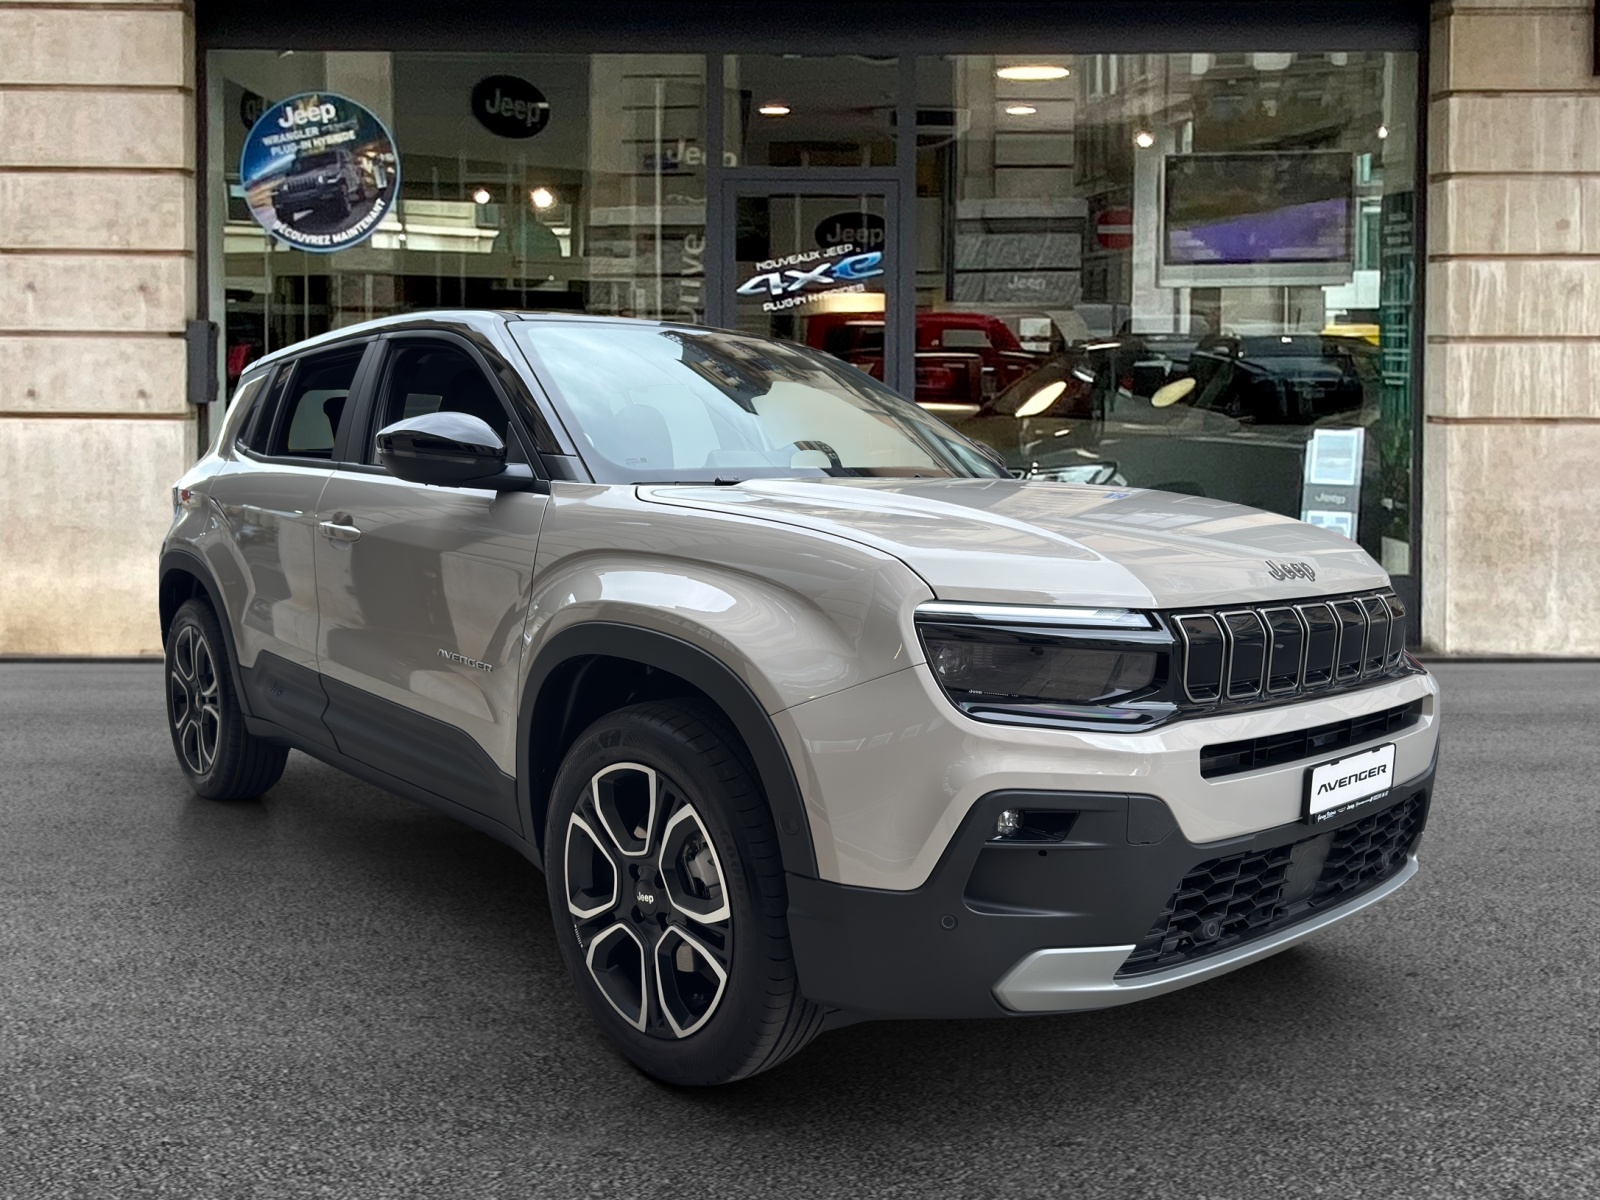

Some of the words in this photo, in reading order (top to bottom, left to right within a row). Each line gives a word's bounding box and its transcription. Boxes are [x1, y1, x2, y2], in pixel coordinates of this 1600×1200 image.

[278, 103, 336, 128] Jeep
[485, 88, 541, 127] Jeep
[262, 127, 320, 146] WRANGLER
[666, 139, 737, 168] Jep
[332, 198, 386, 243] MAINTENANT
[826, 223, 883, 247] Jeep
[756, 251, 820, 271] NOUVEAUX
[823, 243, 853, 258] JEEP
[1265, 559, 1316, 582] Jeep
[437, 648, 494, 674] AVENGER
[1317, 764, 1387, 796] AVENGER
[636, 891, 655, 905] Jeep
